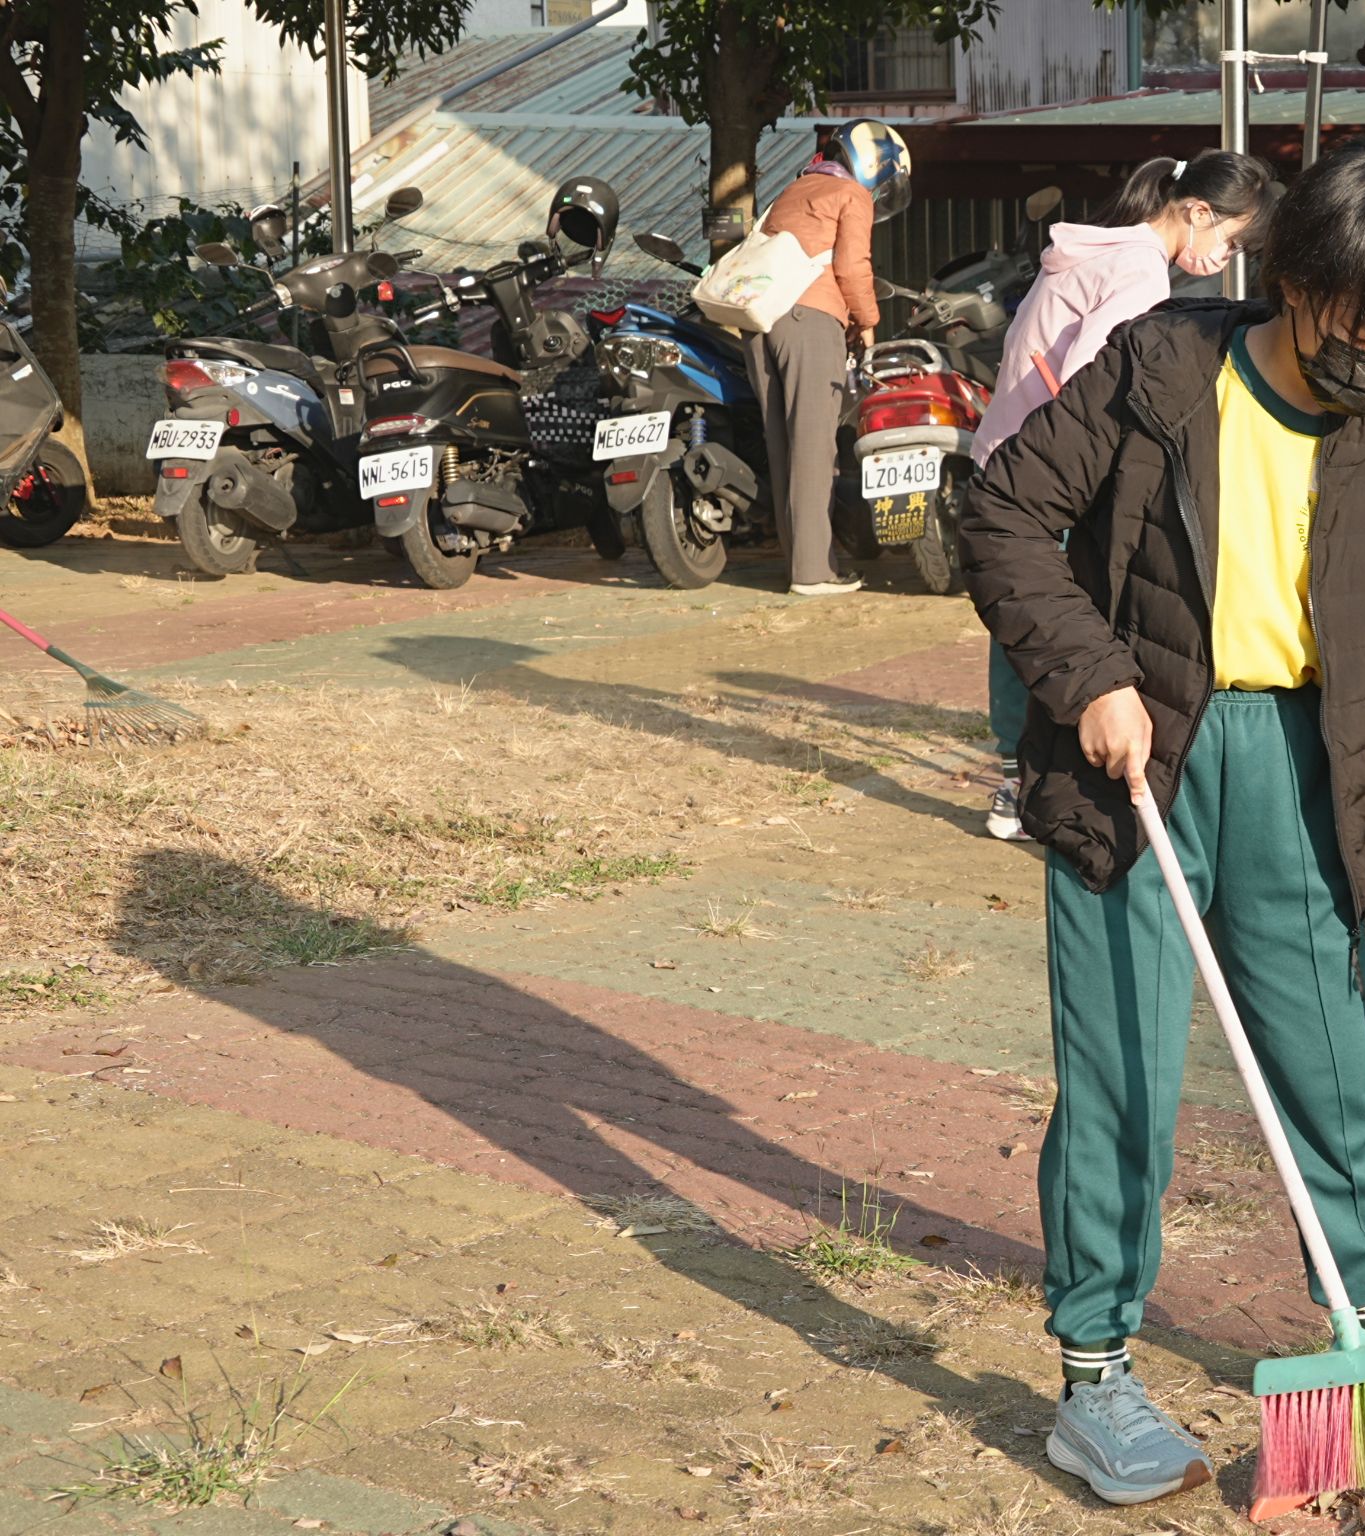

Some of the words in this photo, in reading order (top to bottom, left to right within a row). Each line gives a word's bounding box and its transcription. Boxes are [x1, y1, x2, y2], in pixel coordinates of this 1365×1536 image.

[383, 380, 411, 390] PGO
[150, 430, 217, 450] MBU-2933
[597, 422, 665, 450] MEG-6627
[362, 458, 429, 488] NNL-5615
